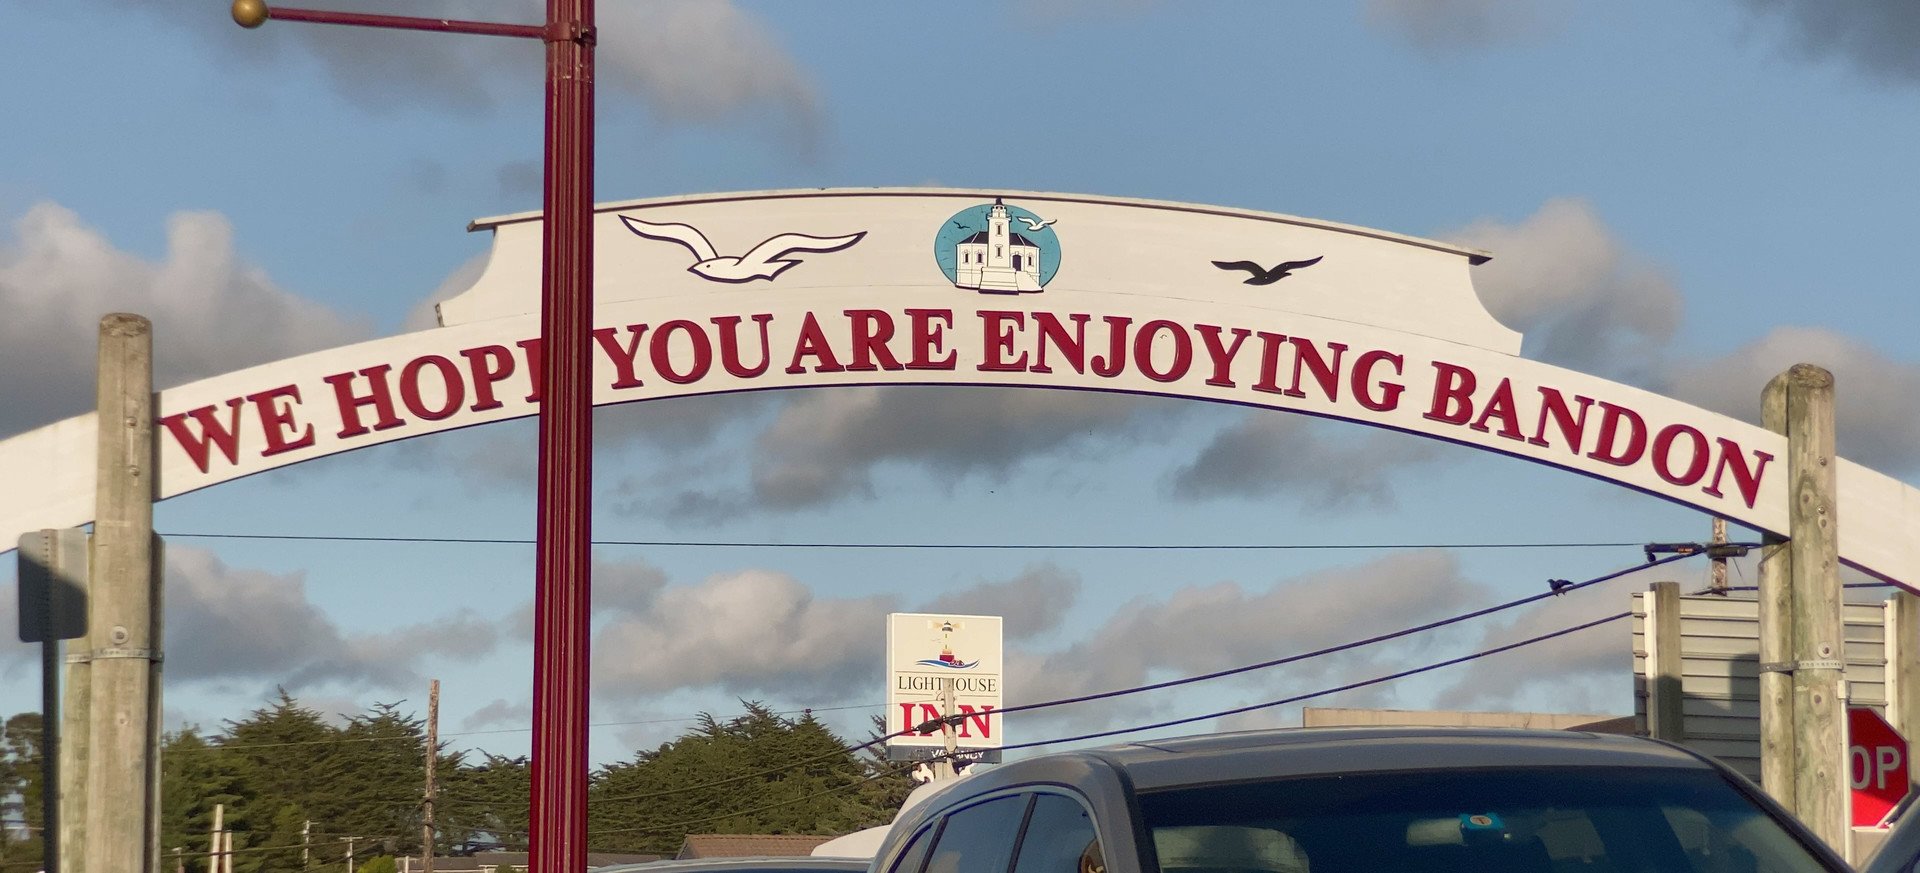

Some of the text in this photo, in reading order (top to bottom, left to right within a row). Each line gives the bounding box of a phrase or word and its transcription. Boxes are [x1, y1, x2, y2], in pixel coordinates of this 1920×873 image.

[159, 383, 316, 475] WE
[592, 313, 774, 388] YOU
[785, 308, 959, 374] ARE
[976, 309, 1406, 413] ENJOYING
[1423, 360, 1775, 510] BANDON
[898, 676, 996, 692] LIGHTOUSE
[899, 702, 994, 738] INN
[931, 748, 985, 760] VAANCY
[1849, 745, 1901, 790] OP
